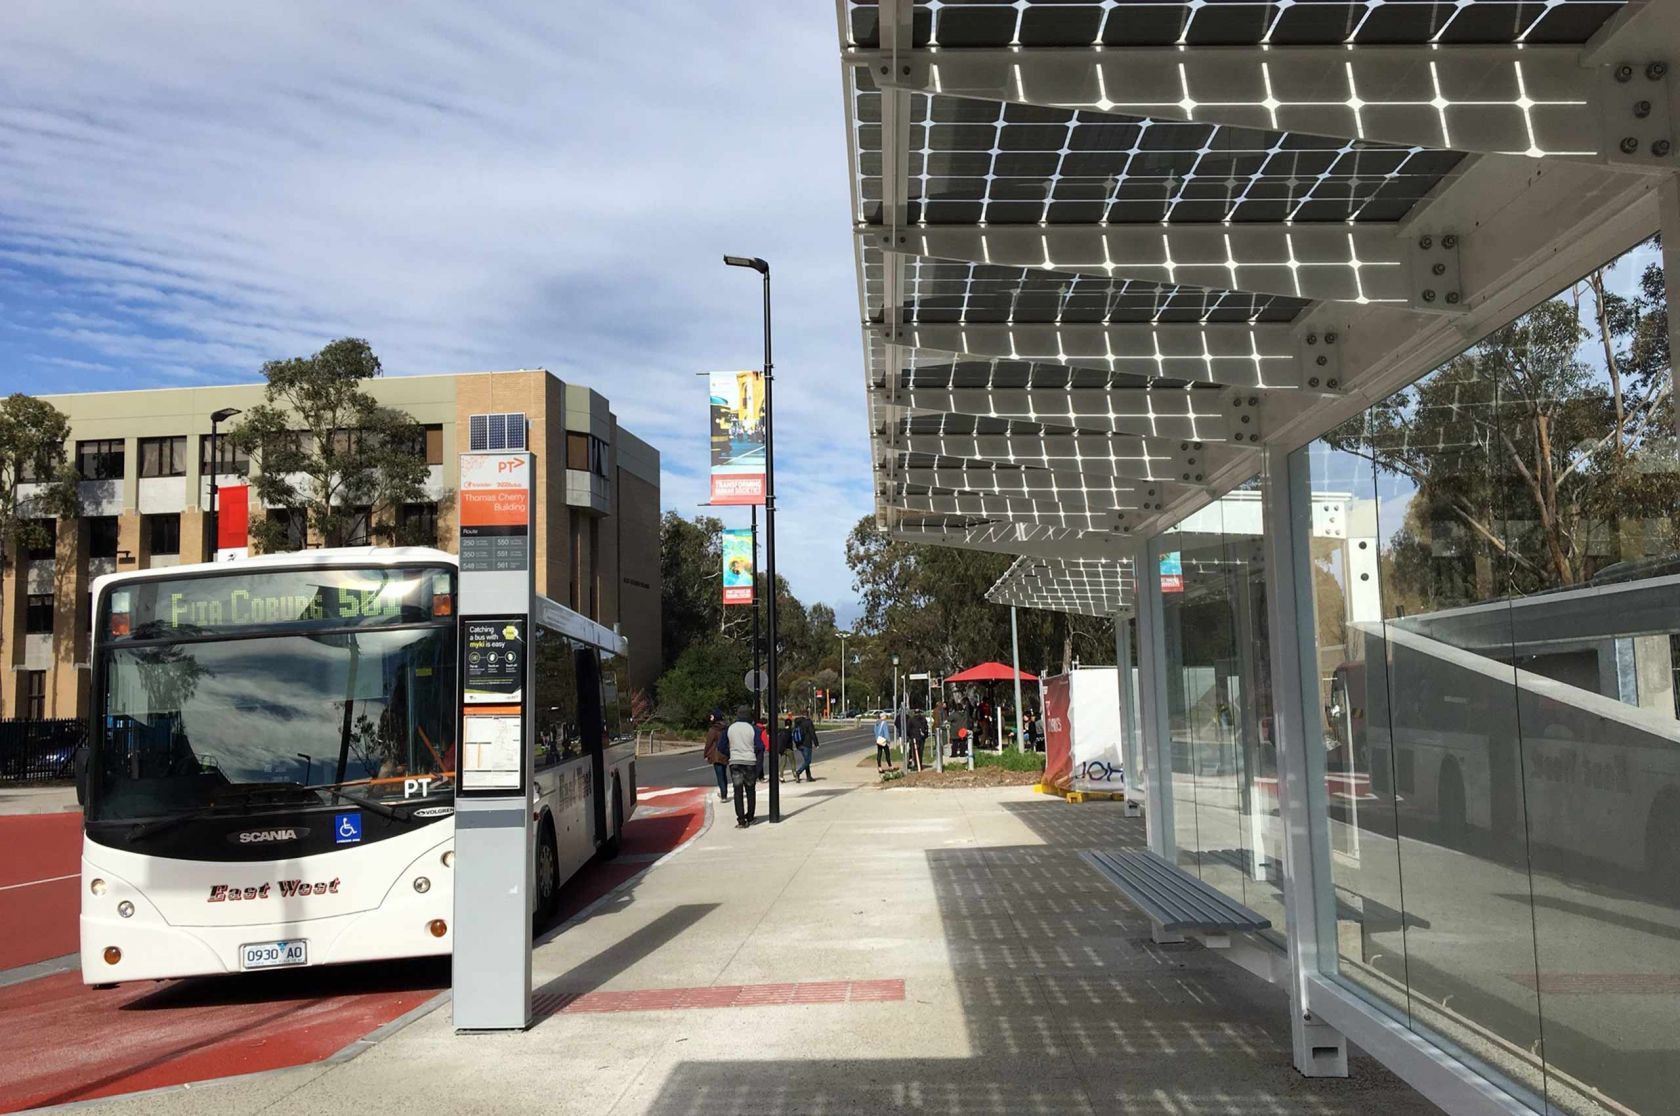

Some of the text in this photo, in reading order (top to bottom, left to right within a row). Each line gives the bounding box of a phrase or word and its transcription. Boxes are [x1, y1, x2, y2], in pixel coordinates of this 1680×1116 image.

[464, 492, 526, 502] Thomas Cherry
[494, 502, 525, 512] Building
[469, 626, 494, 634] Catching
[469, 641, 484, 649] myki
[239, 830, 297, 843] SCANIA
[207, 877, 341, 903] East West
[247, 948, 279, 962] 0930
